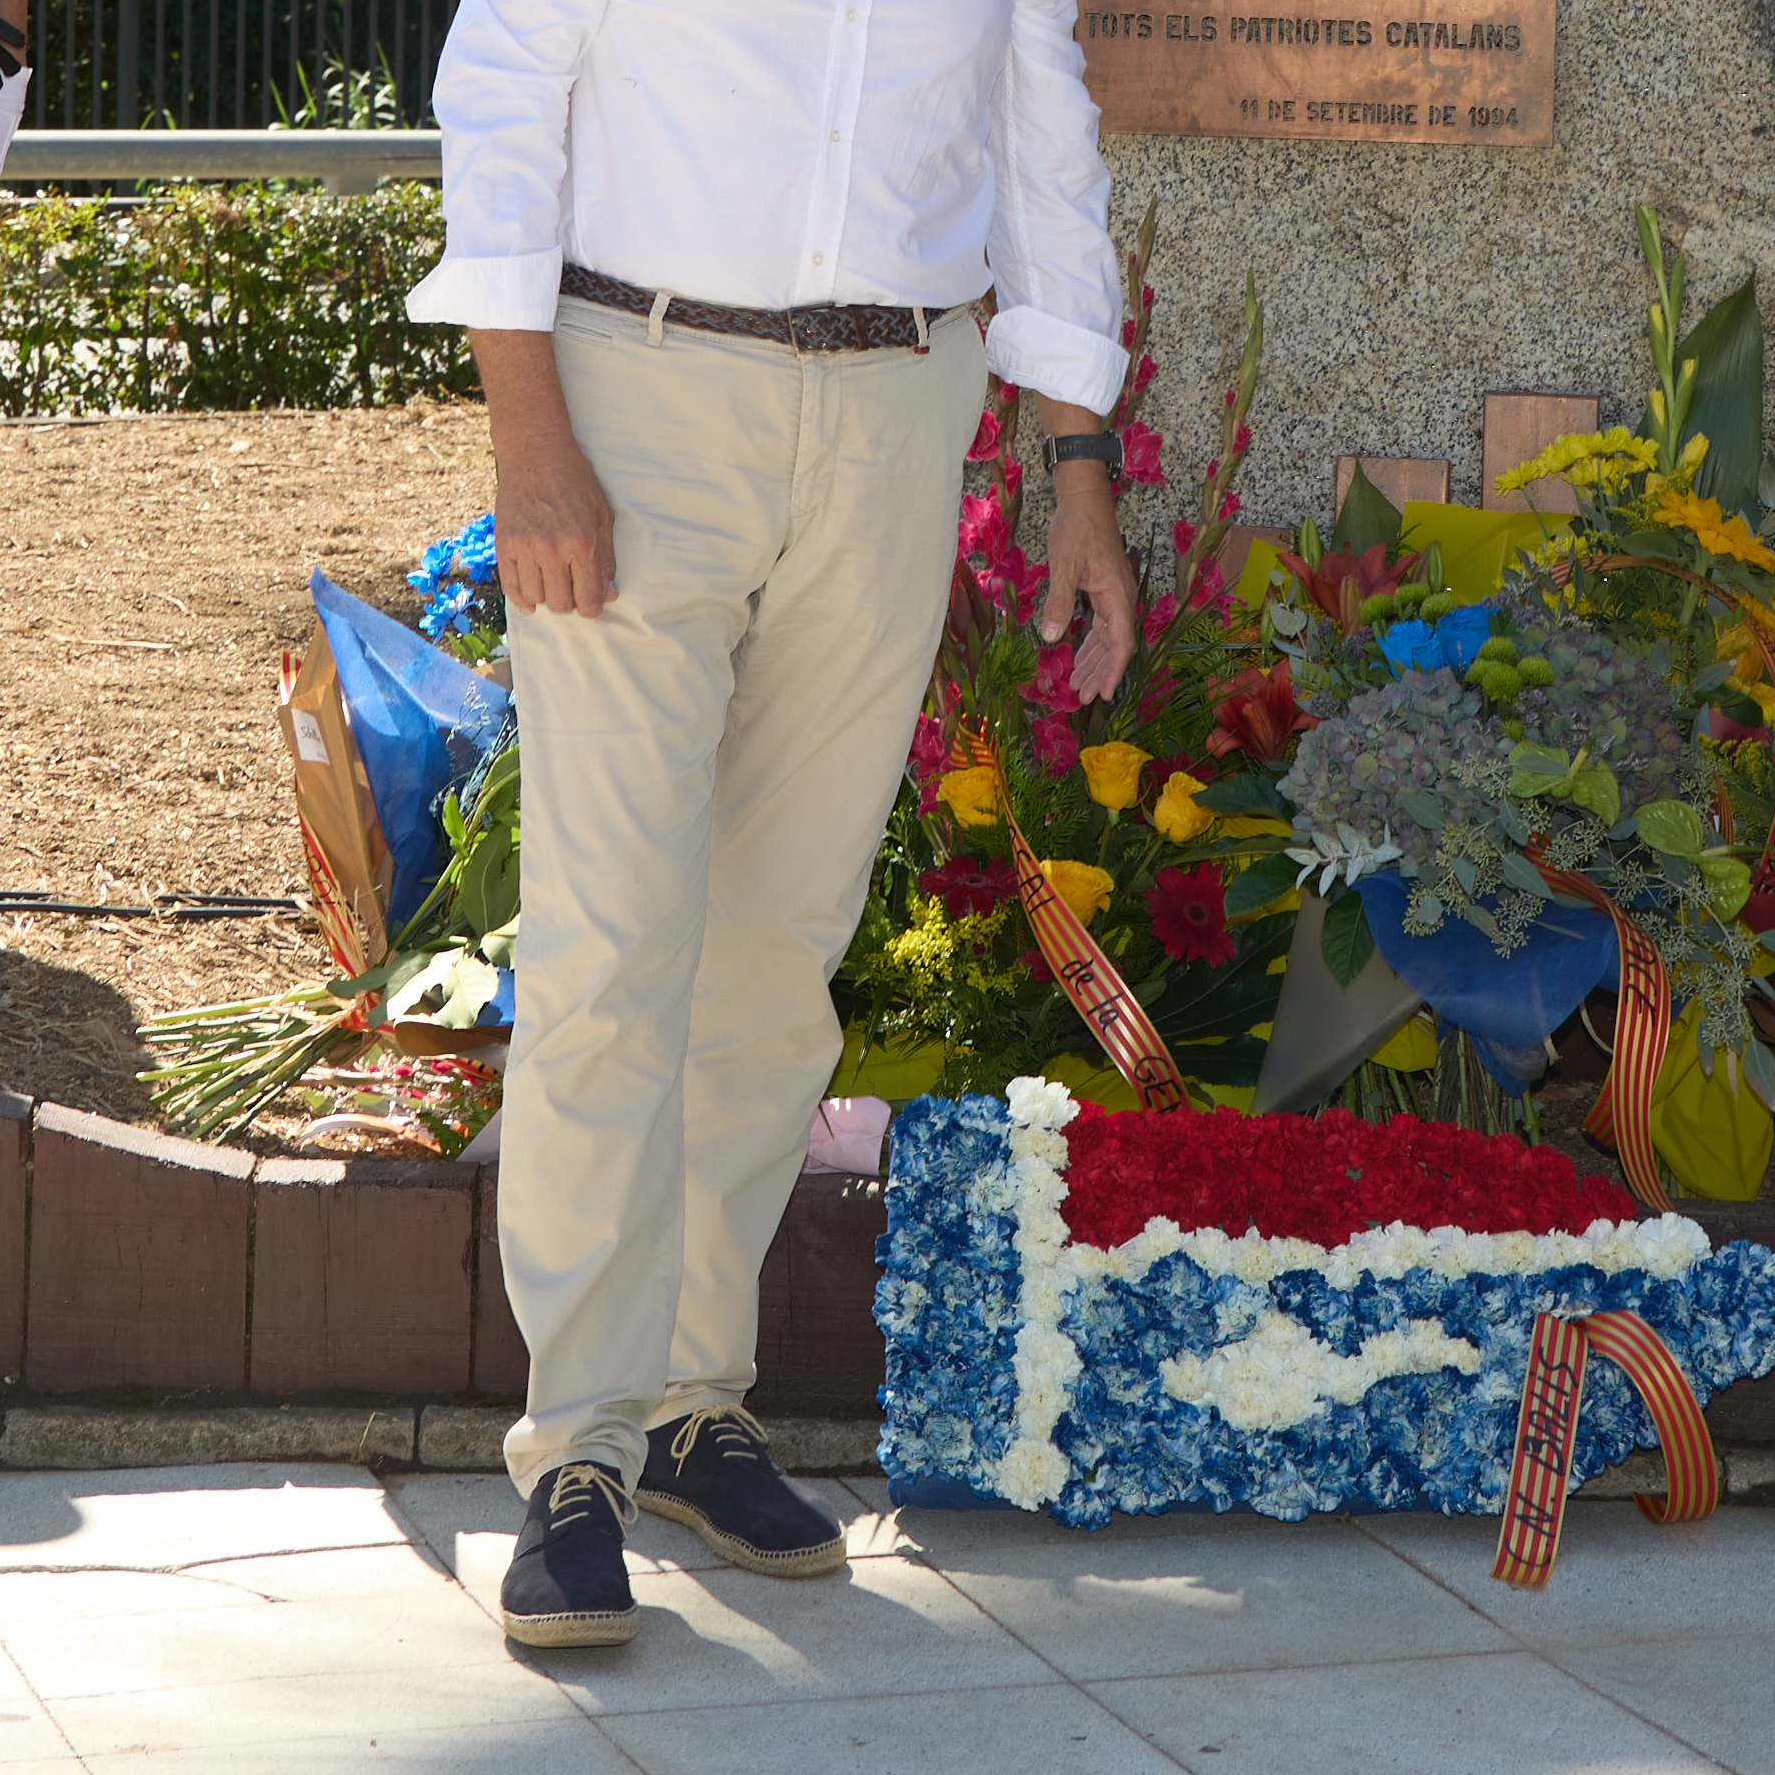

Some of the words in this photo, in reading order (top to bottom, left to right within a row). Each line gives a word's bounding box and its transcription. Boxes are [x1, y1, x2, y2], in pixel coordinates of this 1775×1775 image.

[1085, 12, 1152, 39] TOTS
[1166, 14, 1217, 43] ELS
[1231, 17, 1372, 47] PATRIOTES
[1386, 21, 1521, 53] CATALANS
[1239, 99, 1259, 121] 11
[1268, 100, 1296, 123] DE
[1306, 102, 1418, 126] SETEMBRE
[1429, 105, 1457, 127] DE
[1468, 106, 1519, 129] 1994
[1061, 957, 1094, 997] de
[1087, 991, 1124, 1037] la
